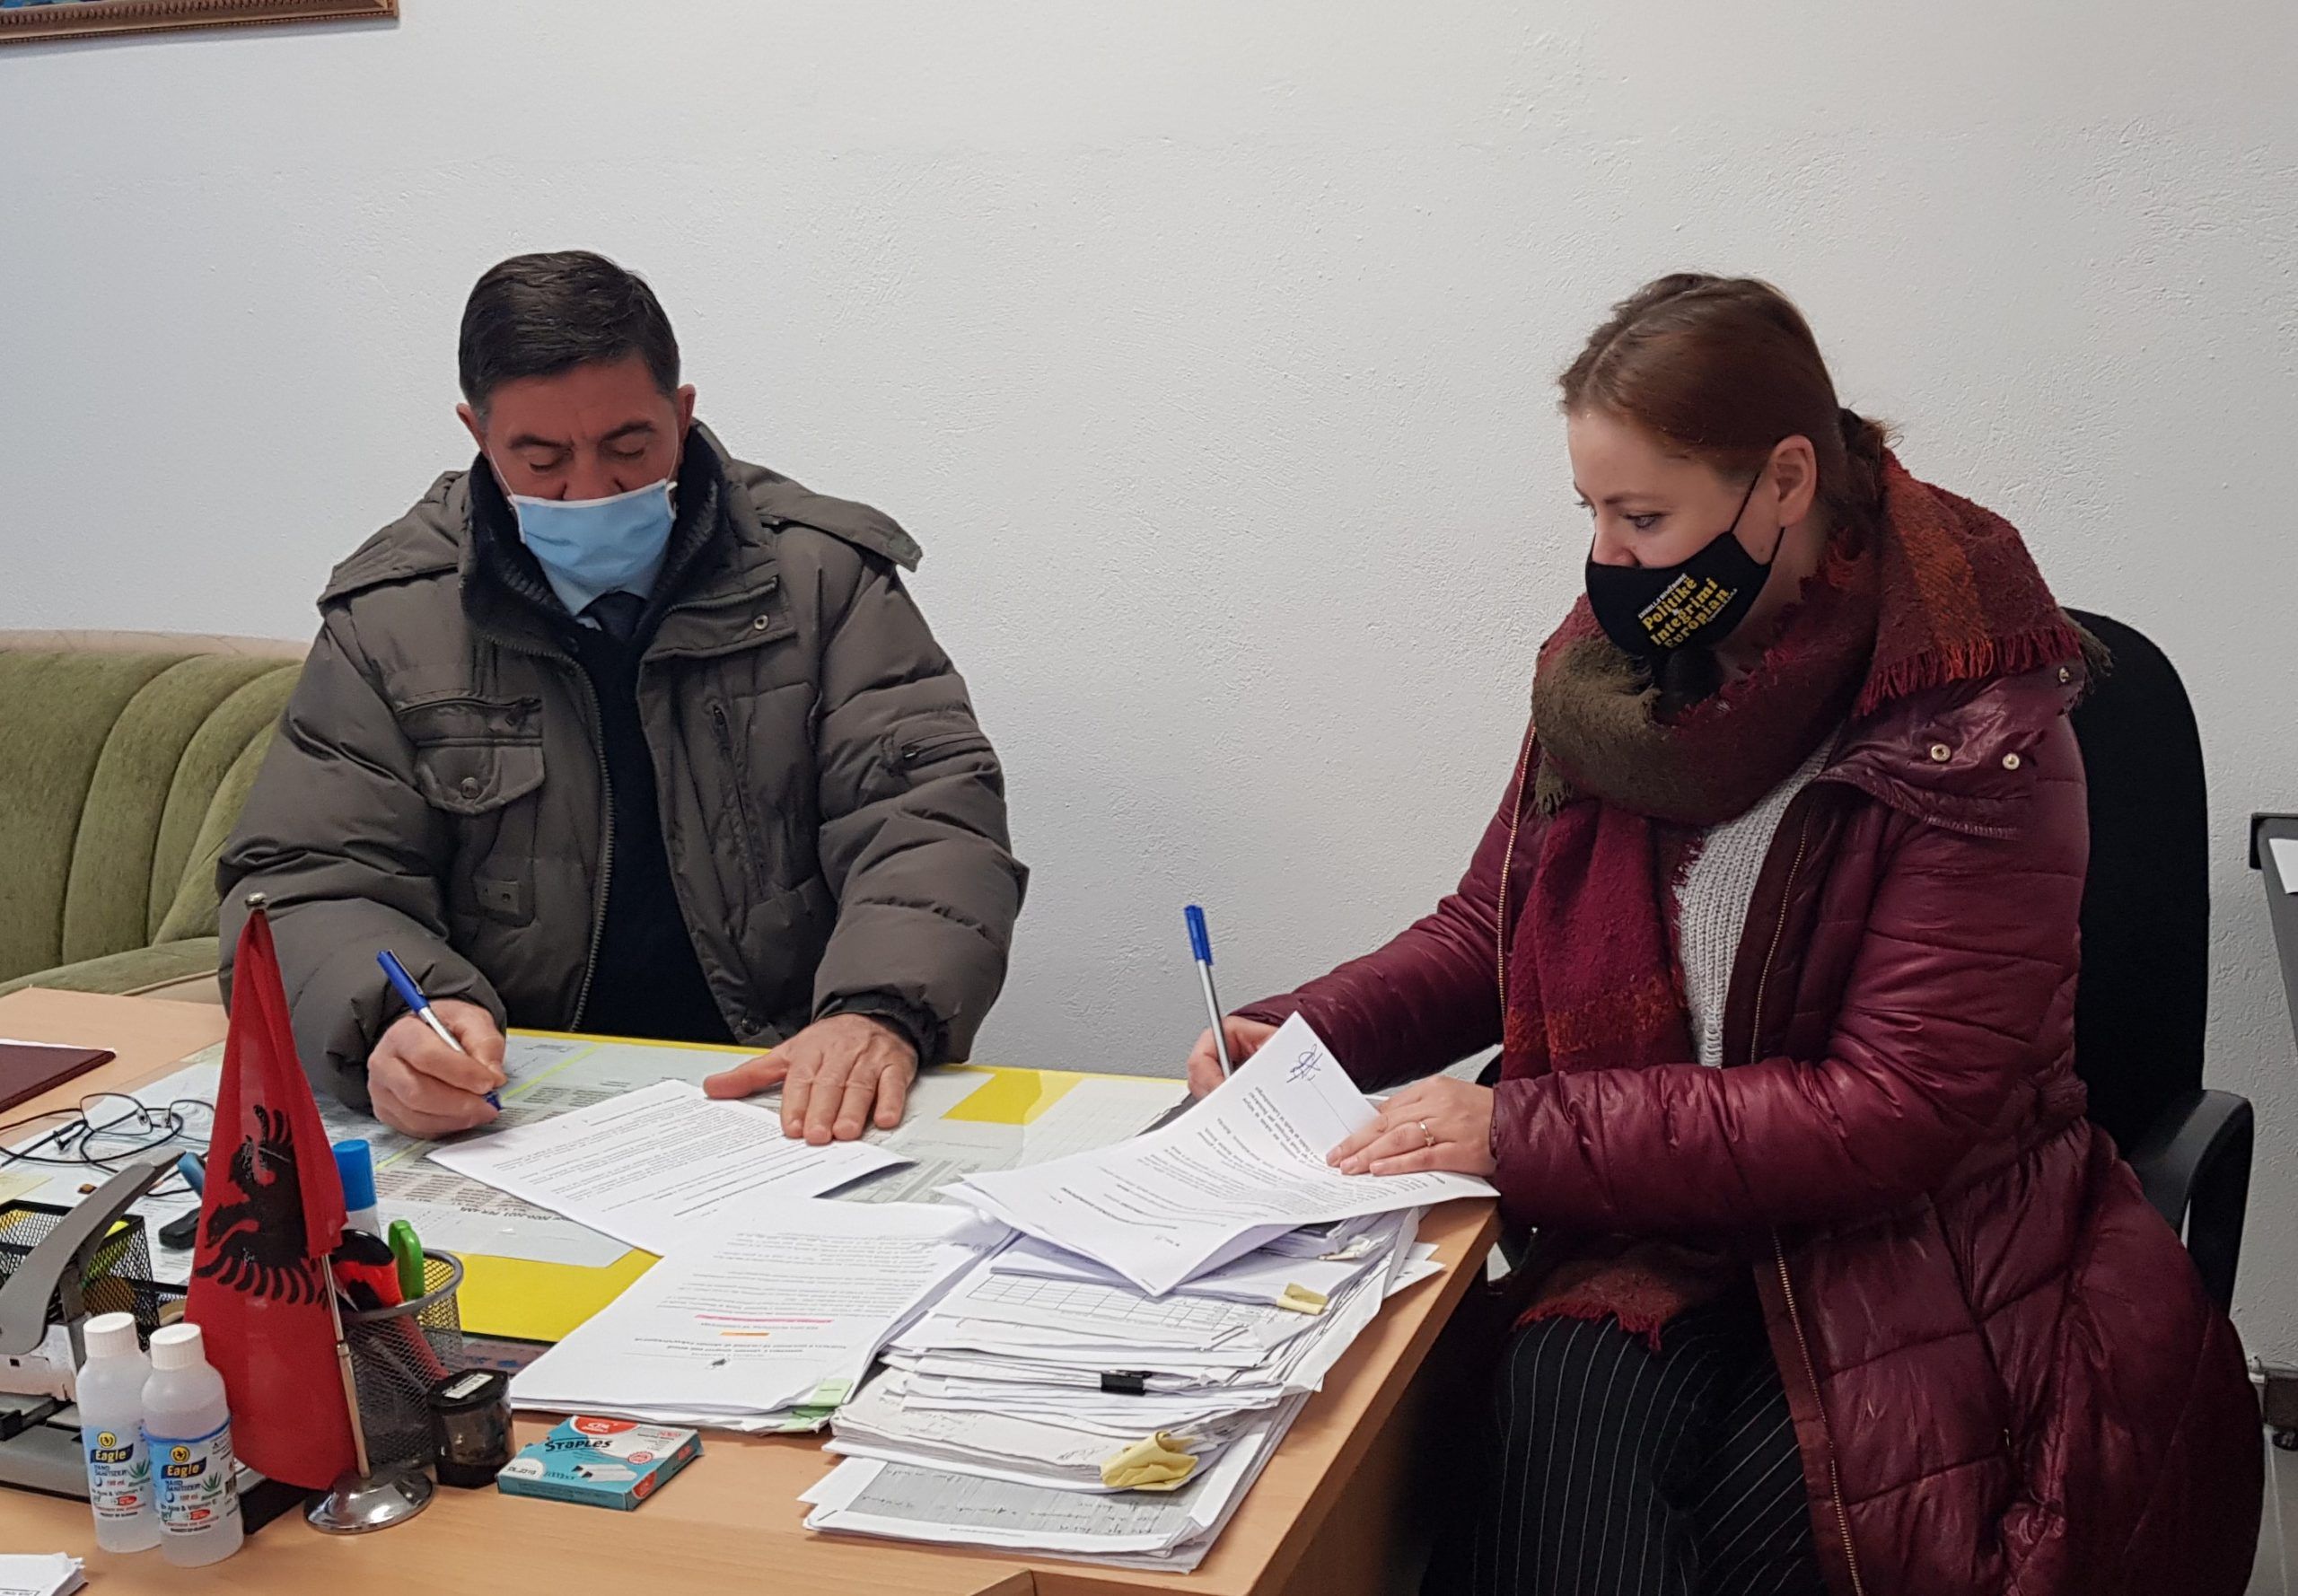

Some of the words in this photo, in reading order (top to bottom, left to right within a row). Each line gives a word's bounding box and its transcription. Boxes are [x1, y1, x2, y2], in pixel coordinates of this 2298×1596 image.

[1642, 577, 1697, 631] Politikë
[1650, 577, 1718, 645] Integrimi
[95, 1450, 127, 1463] Eagle
[167, 1464, 199, 1478] Eagle
